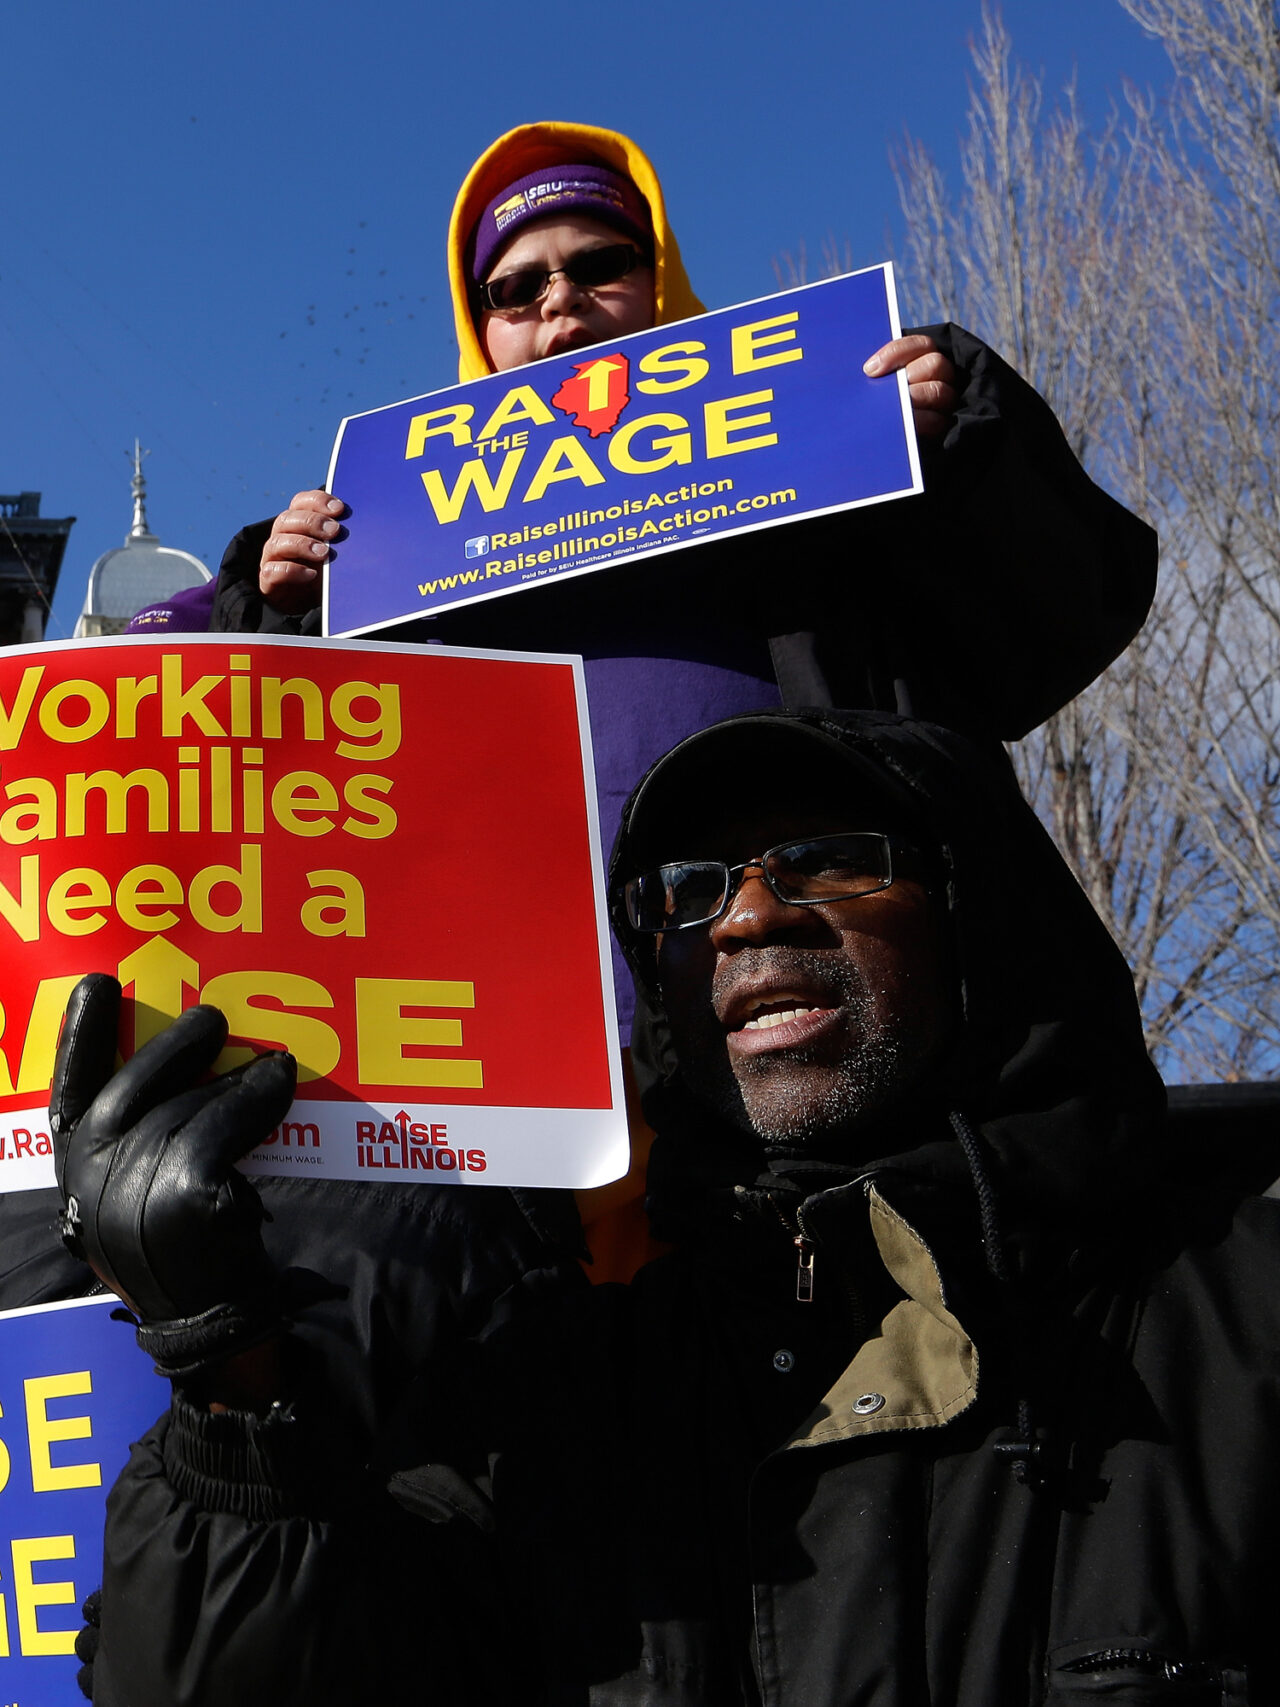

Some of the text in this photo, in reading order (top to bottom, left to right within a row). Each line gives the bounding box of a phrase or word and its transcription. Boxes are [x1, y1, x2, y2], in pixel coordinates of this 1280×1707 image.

[528, 181, 562, 199] SEIU
[405, 311, 803, 460] RAISE
[421, 389, 778, 525] WAGE
[473, 430, 529, 456] THE
[490, 477, 734, 550] RaiseIllinoisAction
[418, 487, 797, 596] www.RaiseIllinoisAction.com
[521, 571, 537, 580] Paid
[537, 568, 548, 577] for
[548, 566, 557, 574] by
[558, 562, 575, 571] SEIU
[575, 551, 612, 566] Healthcare
[636, 539, 662, 550] Indiana
[300, 869, 366, 938] a
[356, 1109, 449, 1147] RAISE
[252, 1153, 293, 1163] MINIMUM
[357, 1145, 487, 1172] ILLINOIS
